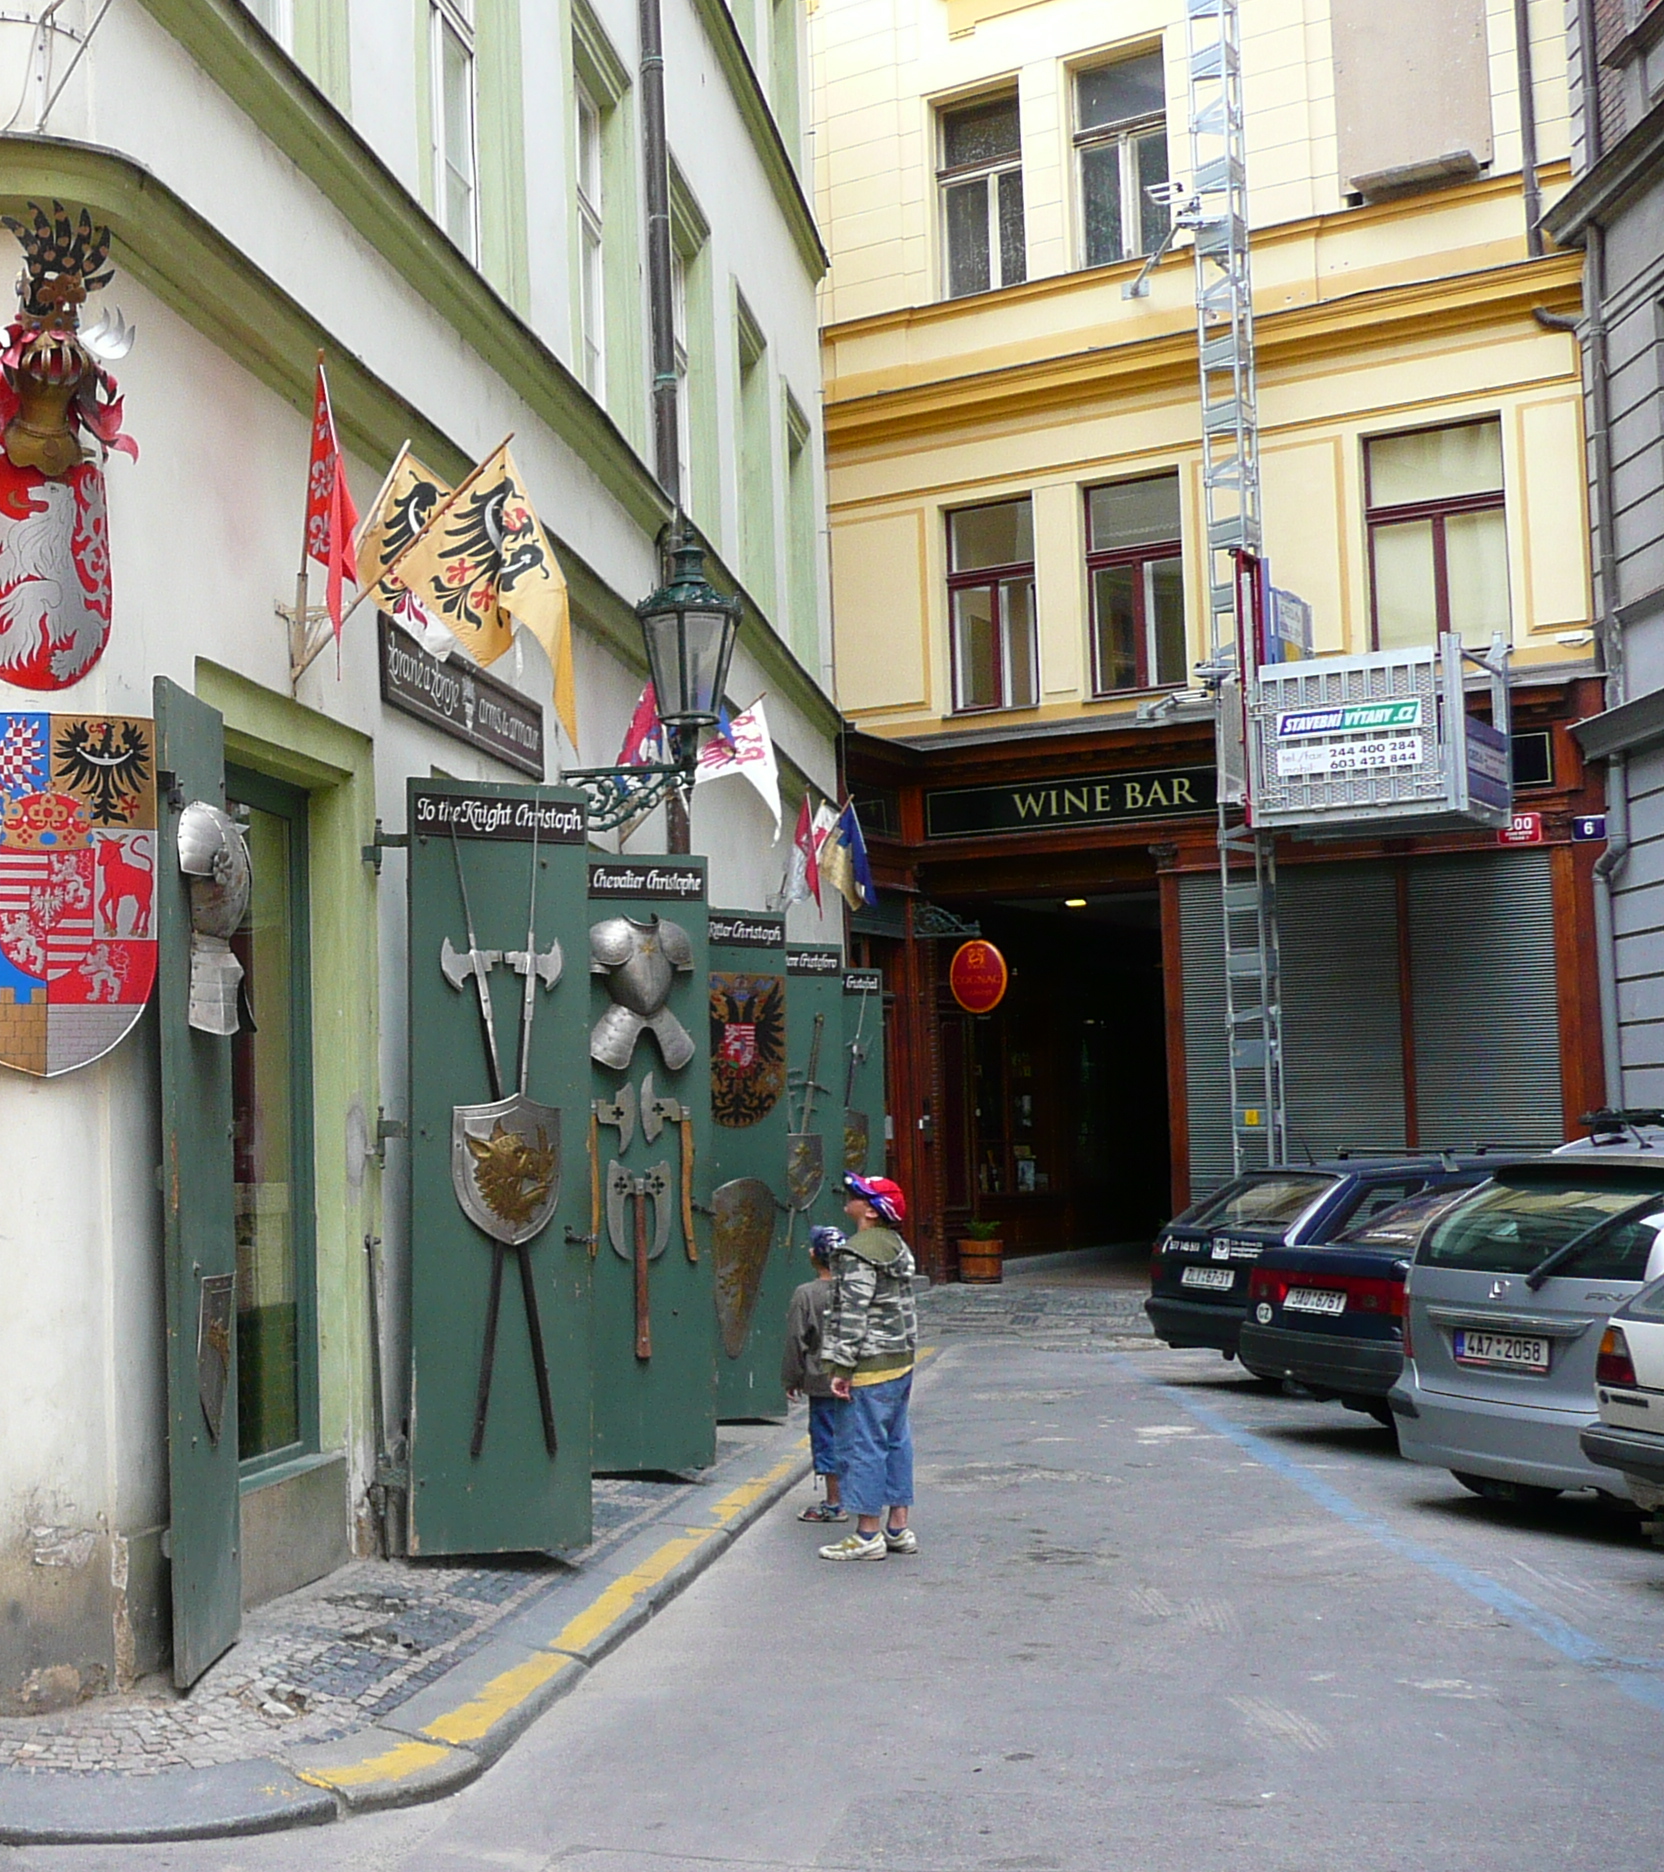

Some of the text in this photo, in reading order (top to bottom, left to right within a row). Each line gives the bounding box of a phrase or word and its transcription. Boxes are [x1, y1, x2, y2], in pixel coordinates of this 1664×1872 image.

[1284, 710, 1343, 732] STAVEBNÍ
[1344, 708, 1392, 727] VÝTAHY
[1329, 746, 1355, 758] 244
[1359, 743, 1385, 754] 400
[1389, 740, 1416, 751] 284
[1330, 759, 1355, 770] 603
[1360, 756, 1385, 766] 422
[1391, 752, 1416, 763] 844
[1013, 778, 1198, 819] WINE BAR
[417, 798, 435, 821] To
[459, 800, 512, 831] Knight
[515, 804, 583, 834] Christoph
[1583, 822, 1594, 835] 6
[593, 868, 701, 896] Chevalier Christophe
[732, 920, 781, 945] Christoph
[1258, 1306, 1270, 1320] CZ
[1468, 1334, 1541, 1361] 4A7 2058
